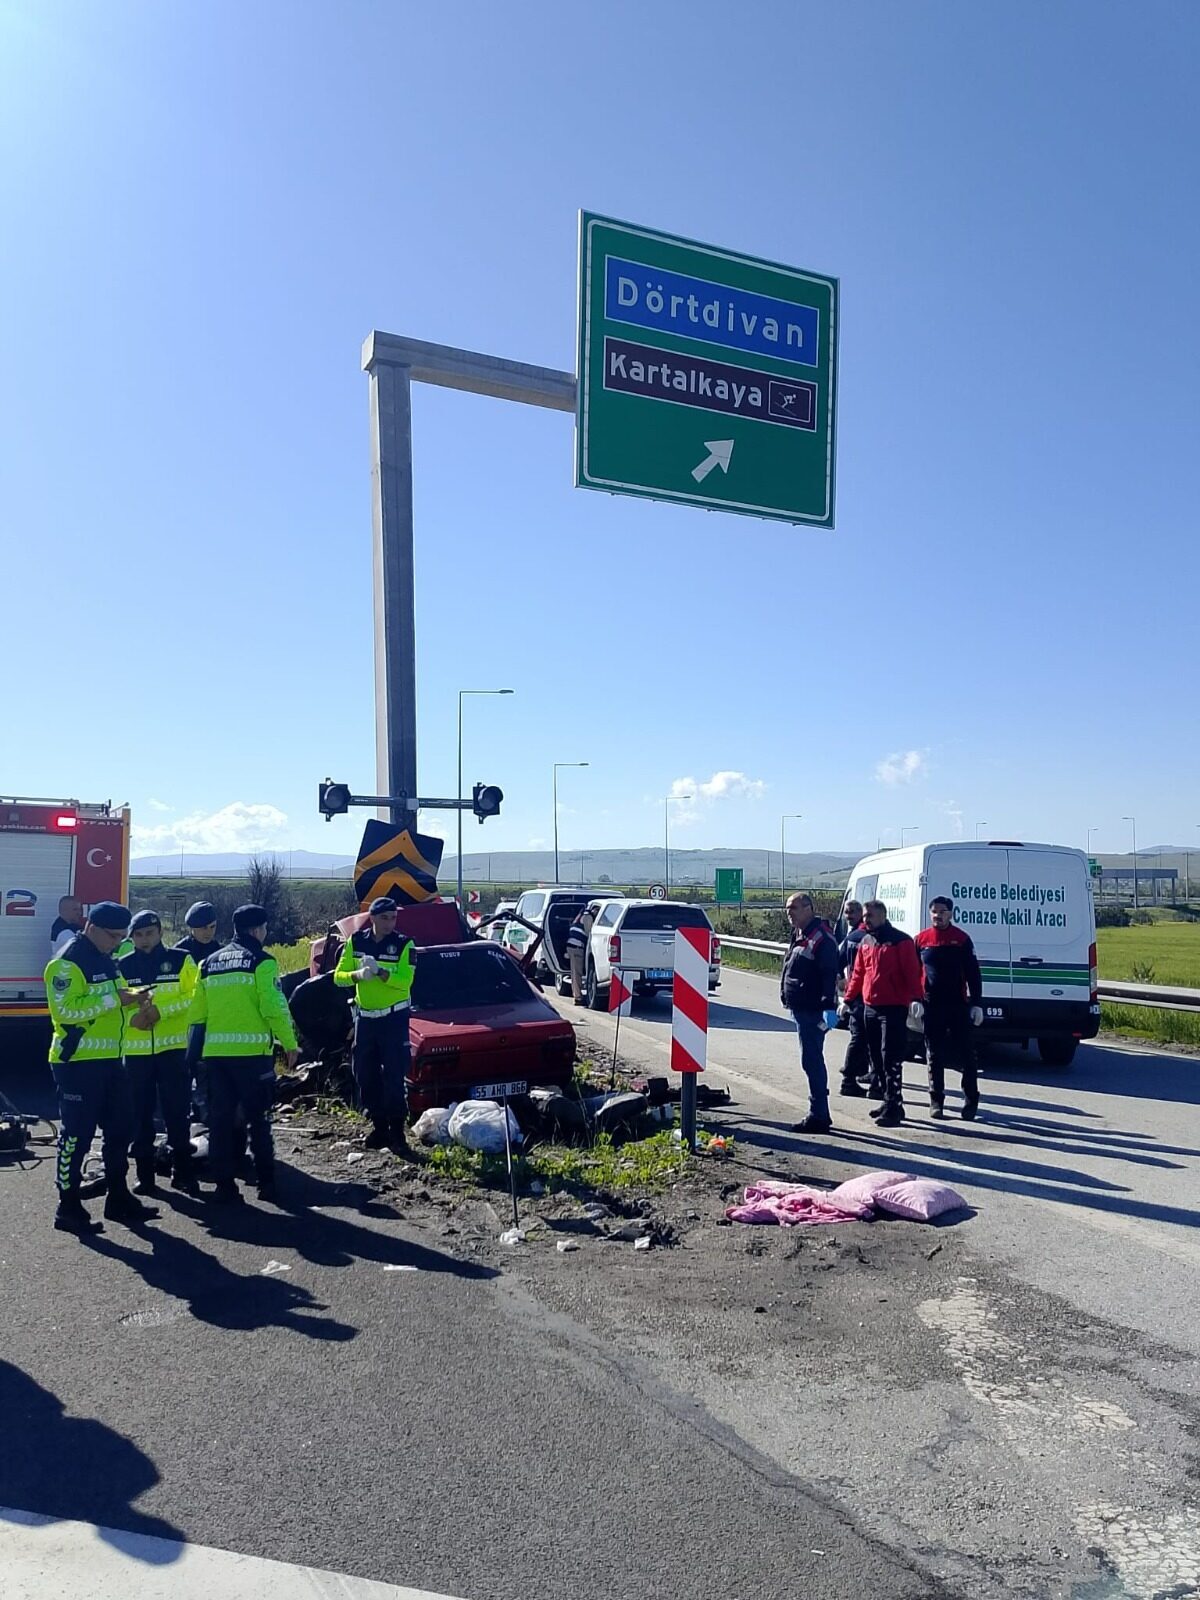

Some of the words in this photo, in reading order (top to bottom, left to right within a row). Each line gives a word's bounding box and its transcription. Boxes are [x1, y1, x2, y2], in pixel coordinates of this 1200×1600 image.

[617, 276, 803, 348] Dörtdivan
[609, 352, 762, 408] Kartalkaya
[652, 888, 664, 898] 50
[951, 881, 997, 900] Gerede
[1000, 883, 1065, 906] Belediyesi
[953, 905, 997, 925] Cenaze
[1001, 907, 1032, 926] Nakil
[1035, 909, 1067, 927] Aracı
[476, 1086, 487, 1098] 55
